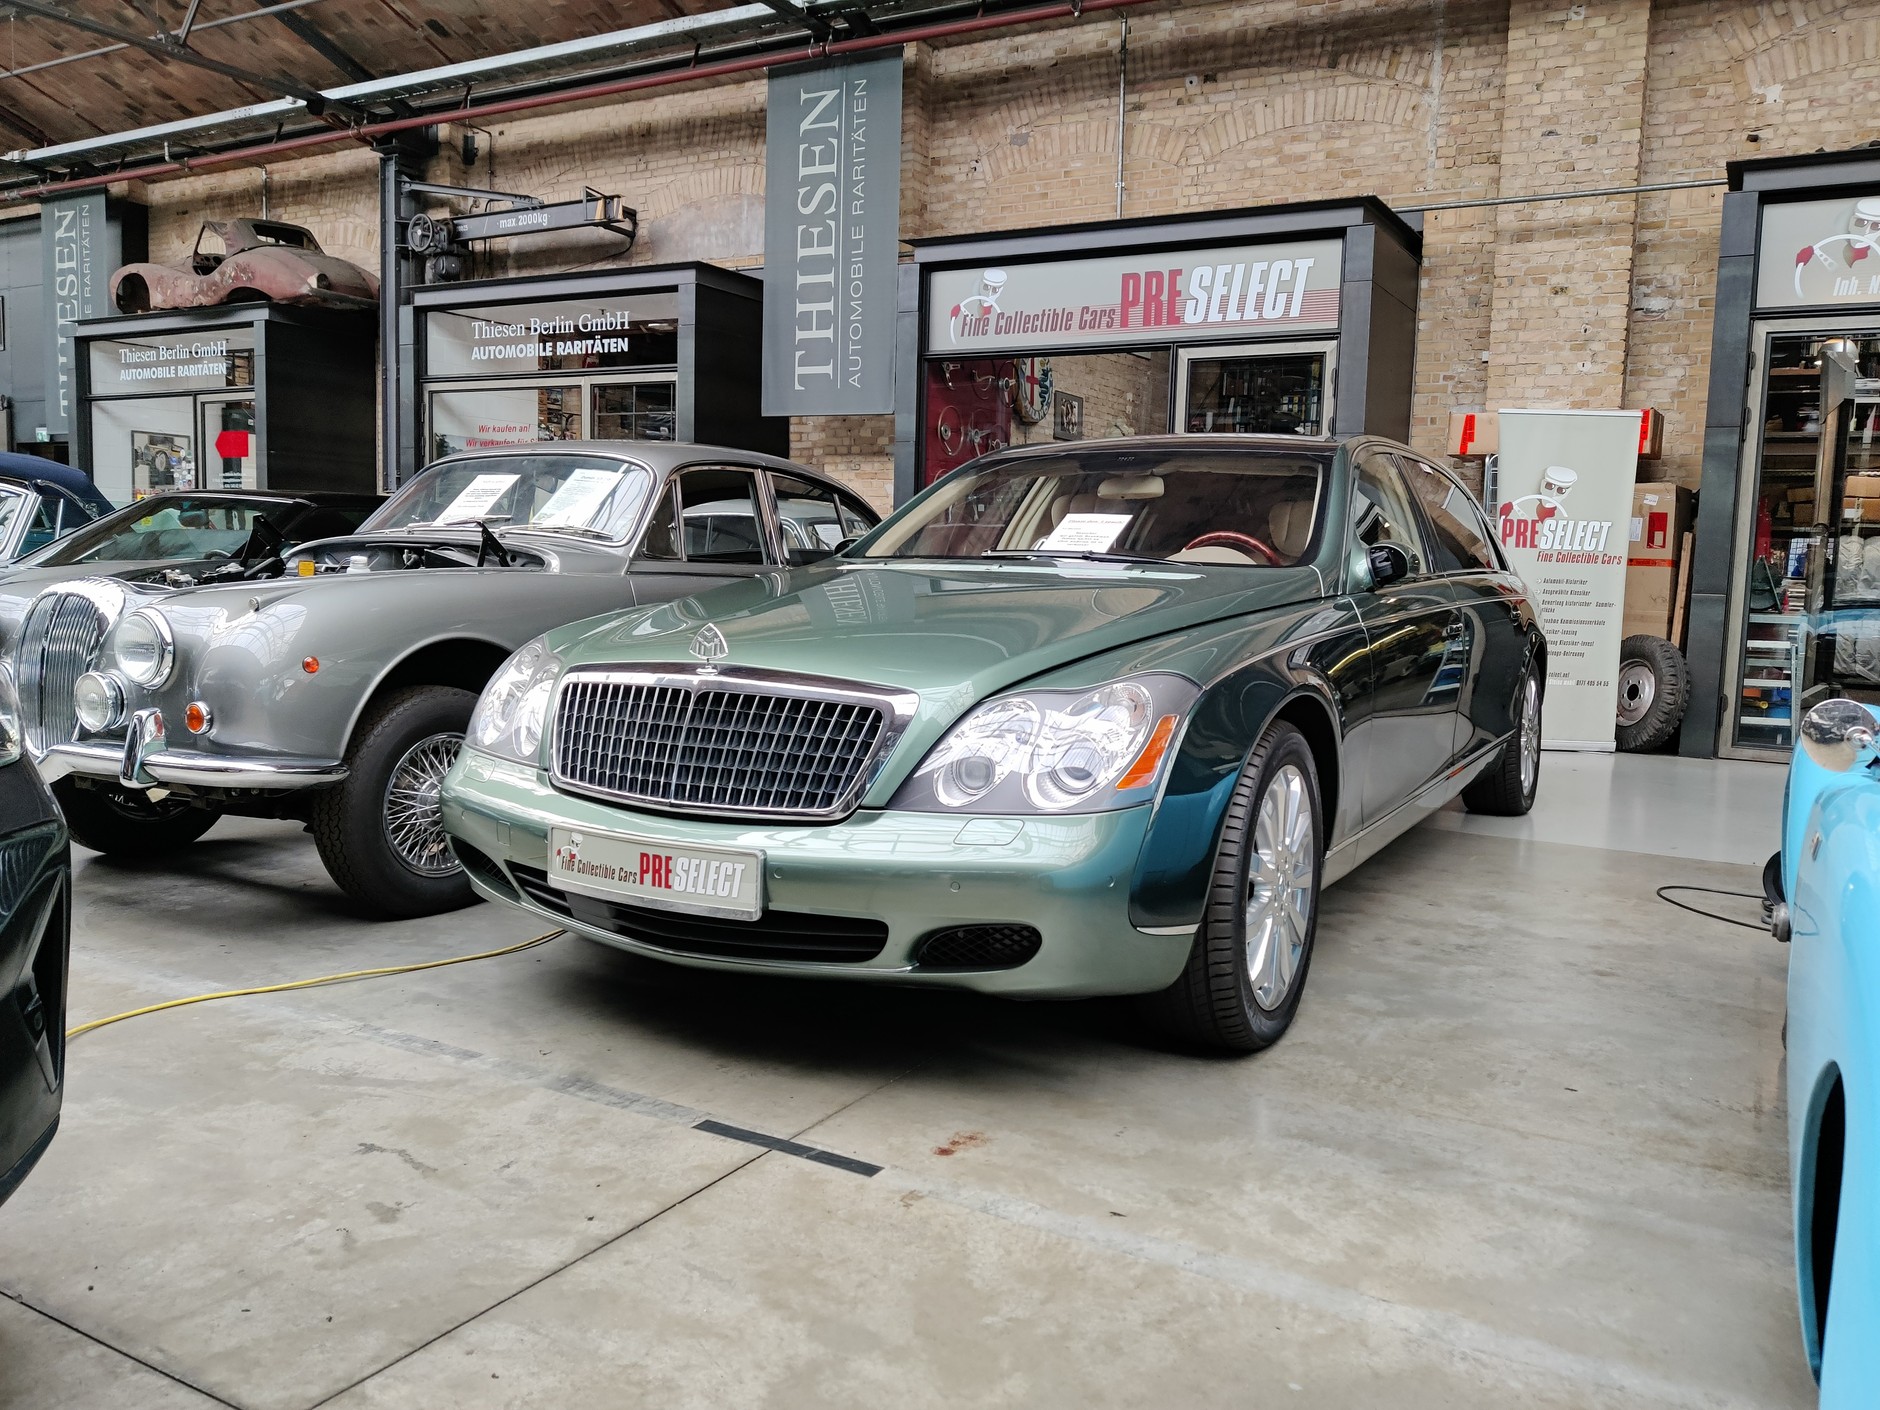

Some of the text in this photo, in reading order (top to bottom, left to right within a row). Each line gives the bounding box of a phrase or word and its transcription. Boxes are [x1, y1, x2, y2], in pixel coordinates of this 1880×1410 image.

[794, 87, 840, 391] THIESEN
[848, 78, 868, 388] AUTOMOBILE RARITÄTEN
[80, 204, 90, 299] RARITÄTEN
[1833, 275, 1862, 297] Inh.
[471, 311, 630, 339] Thiesen Berlin GmbH
[960, 312, 989, 338] Fine
[994, 306, 1073, 335] Collectible
[1078, 305, 1116, 330] Cars
[119, 340, 227, 364] Thiesen Berlin GmbH
[471, 335, 629, 361] AUTOMOBILE RARITÄTEN
[120, 361, 227, 382] AUTOMOBILE RARITÄTEN
[478, 423, 531, 433] Wir kaufen an!
[466, 438, 477, 447] Wir
[1537, 551, 1623, 566] Fine Collectible Cars
[560, 855, 575, 871] Fine
[577, 859, 616, 881] Collectible
[618, 866, 638, 885] Cars
